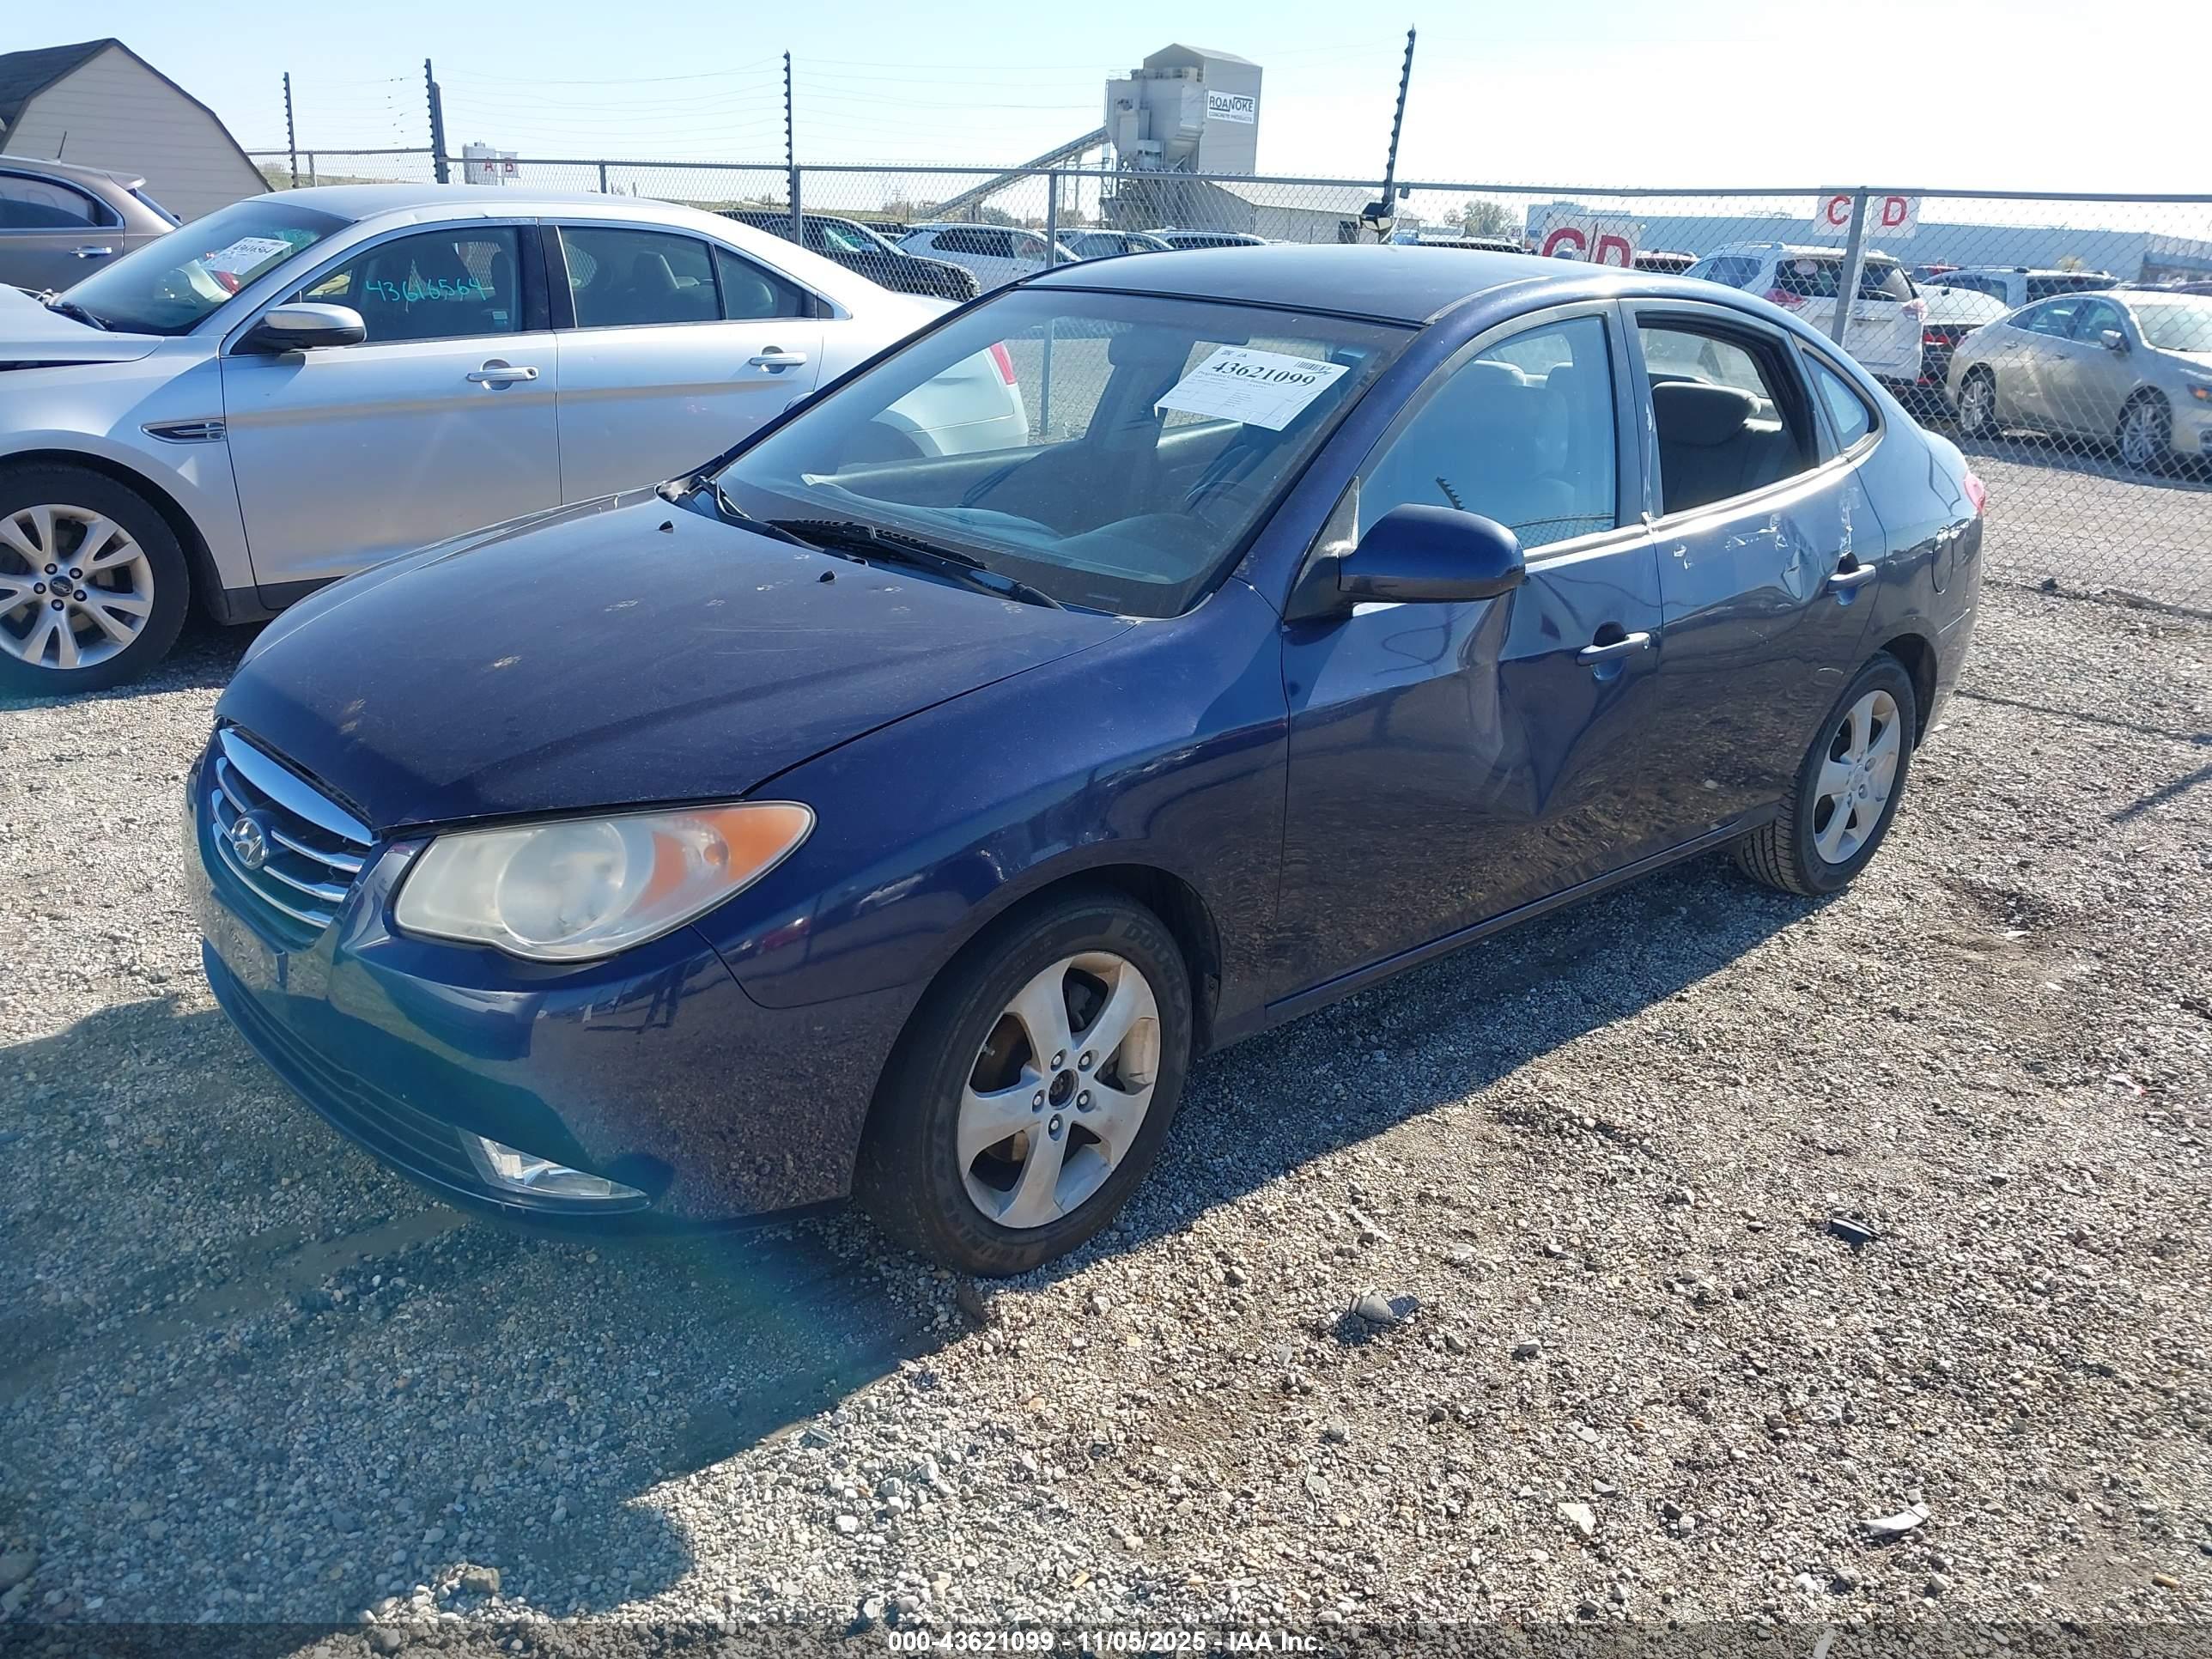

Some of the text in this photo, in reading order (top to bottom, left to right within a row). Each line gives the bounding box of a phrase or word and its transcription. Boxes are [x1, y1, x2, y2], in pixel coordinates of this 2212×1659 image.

[1209, 96, 1254, 112] ROANOKE
[1827, 195, 1851, 226] C
[1882, 197, 1908, 227] D
[366, 277, 487, 302] 43616564
[1212, 361, 1316, 387] 43621099
